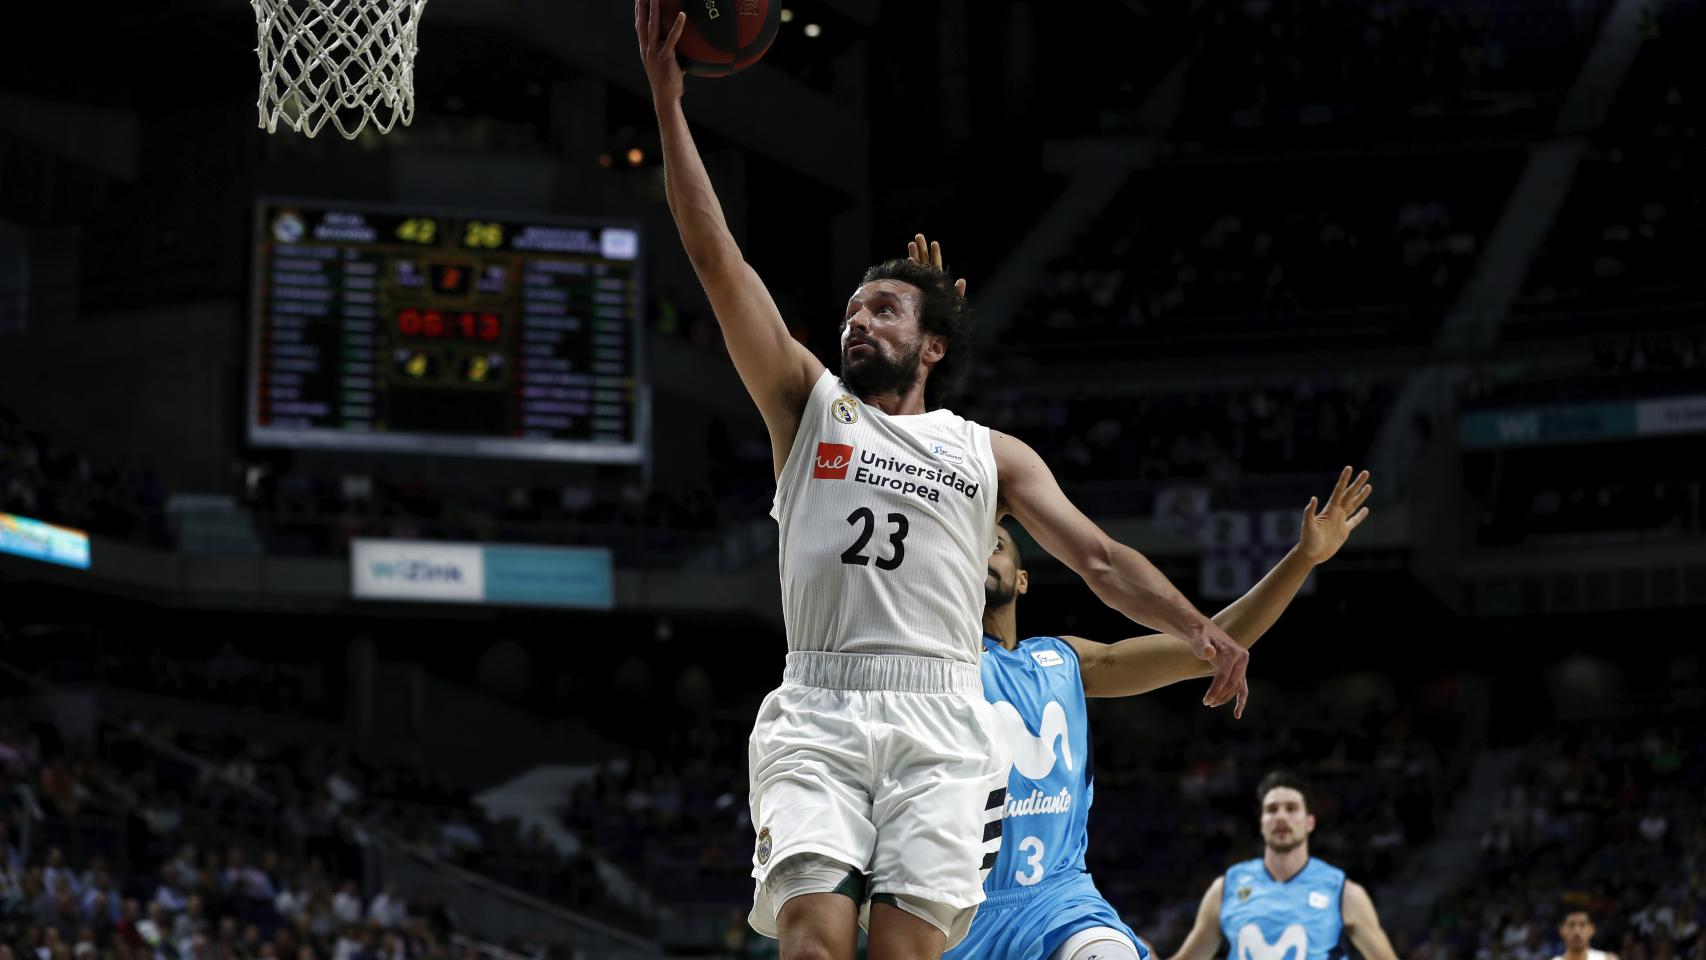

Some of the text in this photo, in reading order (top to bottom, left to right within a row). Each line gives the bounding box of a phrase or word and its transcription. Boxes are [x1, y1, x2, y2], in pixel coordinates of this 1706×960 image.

[396, 218, 437, 244] 42
[854, 467, 939, 503] Europea
[860, 449, 979, 500] Universidad
[840, 506, 910, 571] 23
[1015, 835, 1045, 887] 3
